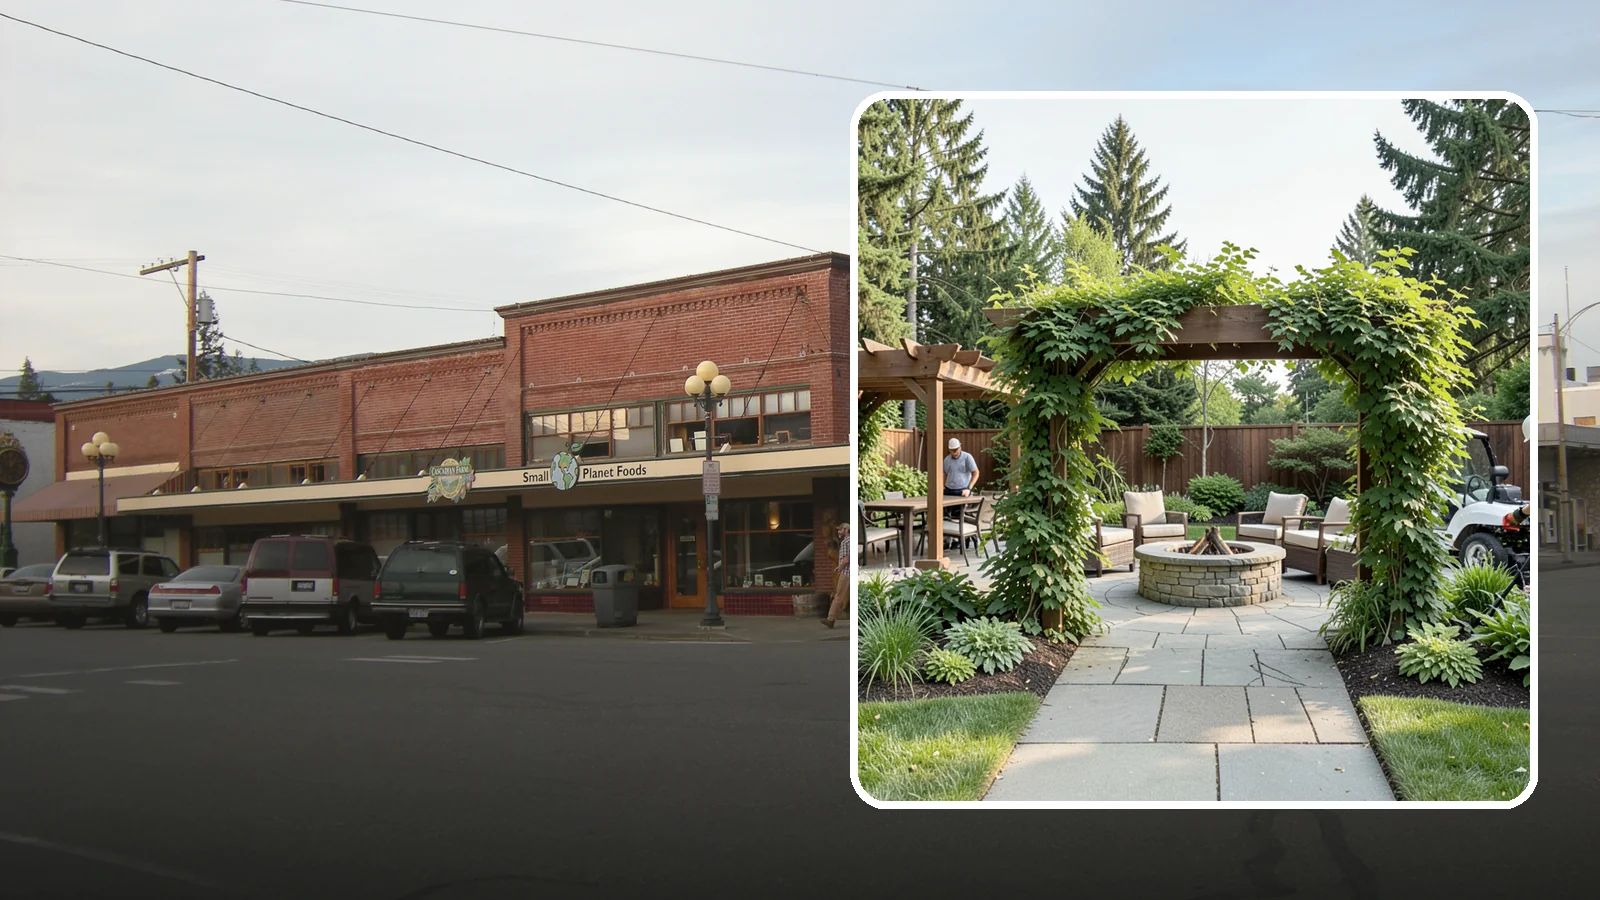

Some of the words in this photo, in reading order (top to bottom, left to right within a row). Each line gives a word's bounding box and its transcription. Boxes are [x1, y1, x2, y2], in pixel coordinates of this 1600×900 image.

[523, 470, 549, 483] Small
[582, 467, 614, 479] Planet
[616, 464, 647, 477] Foods
